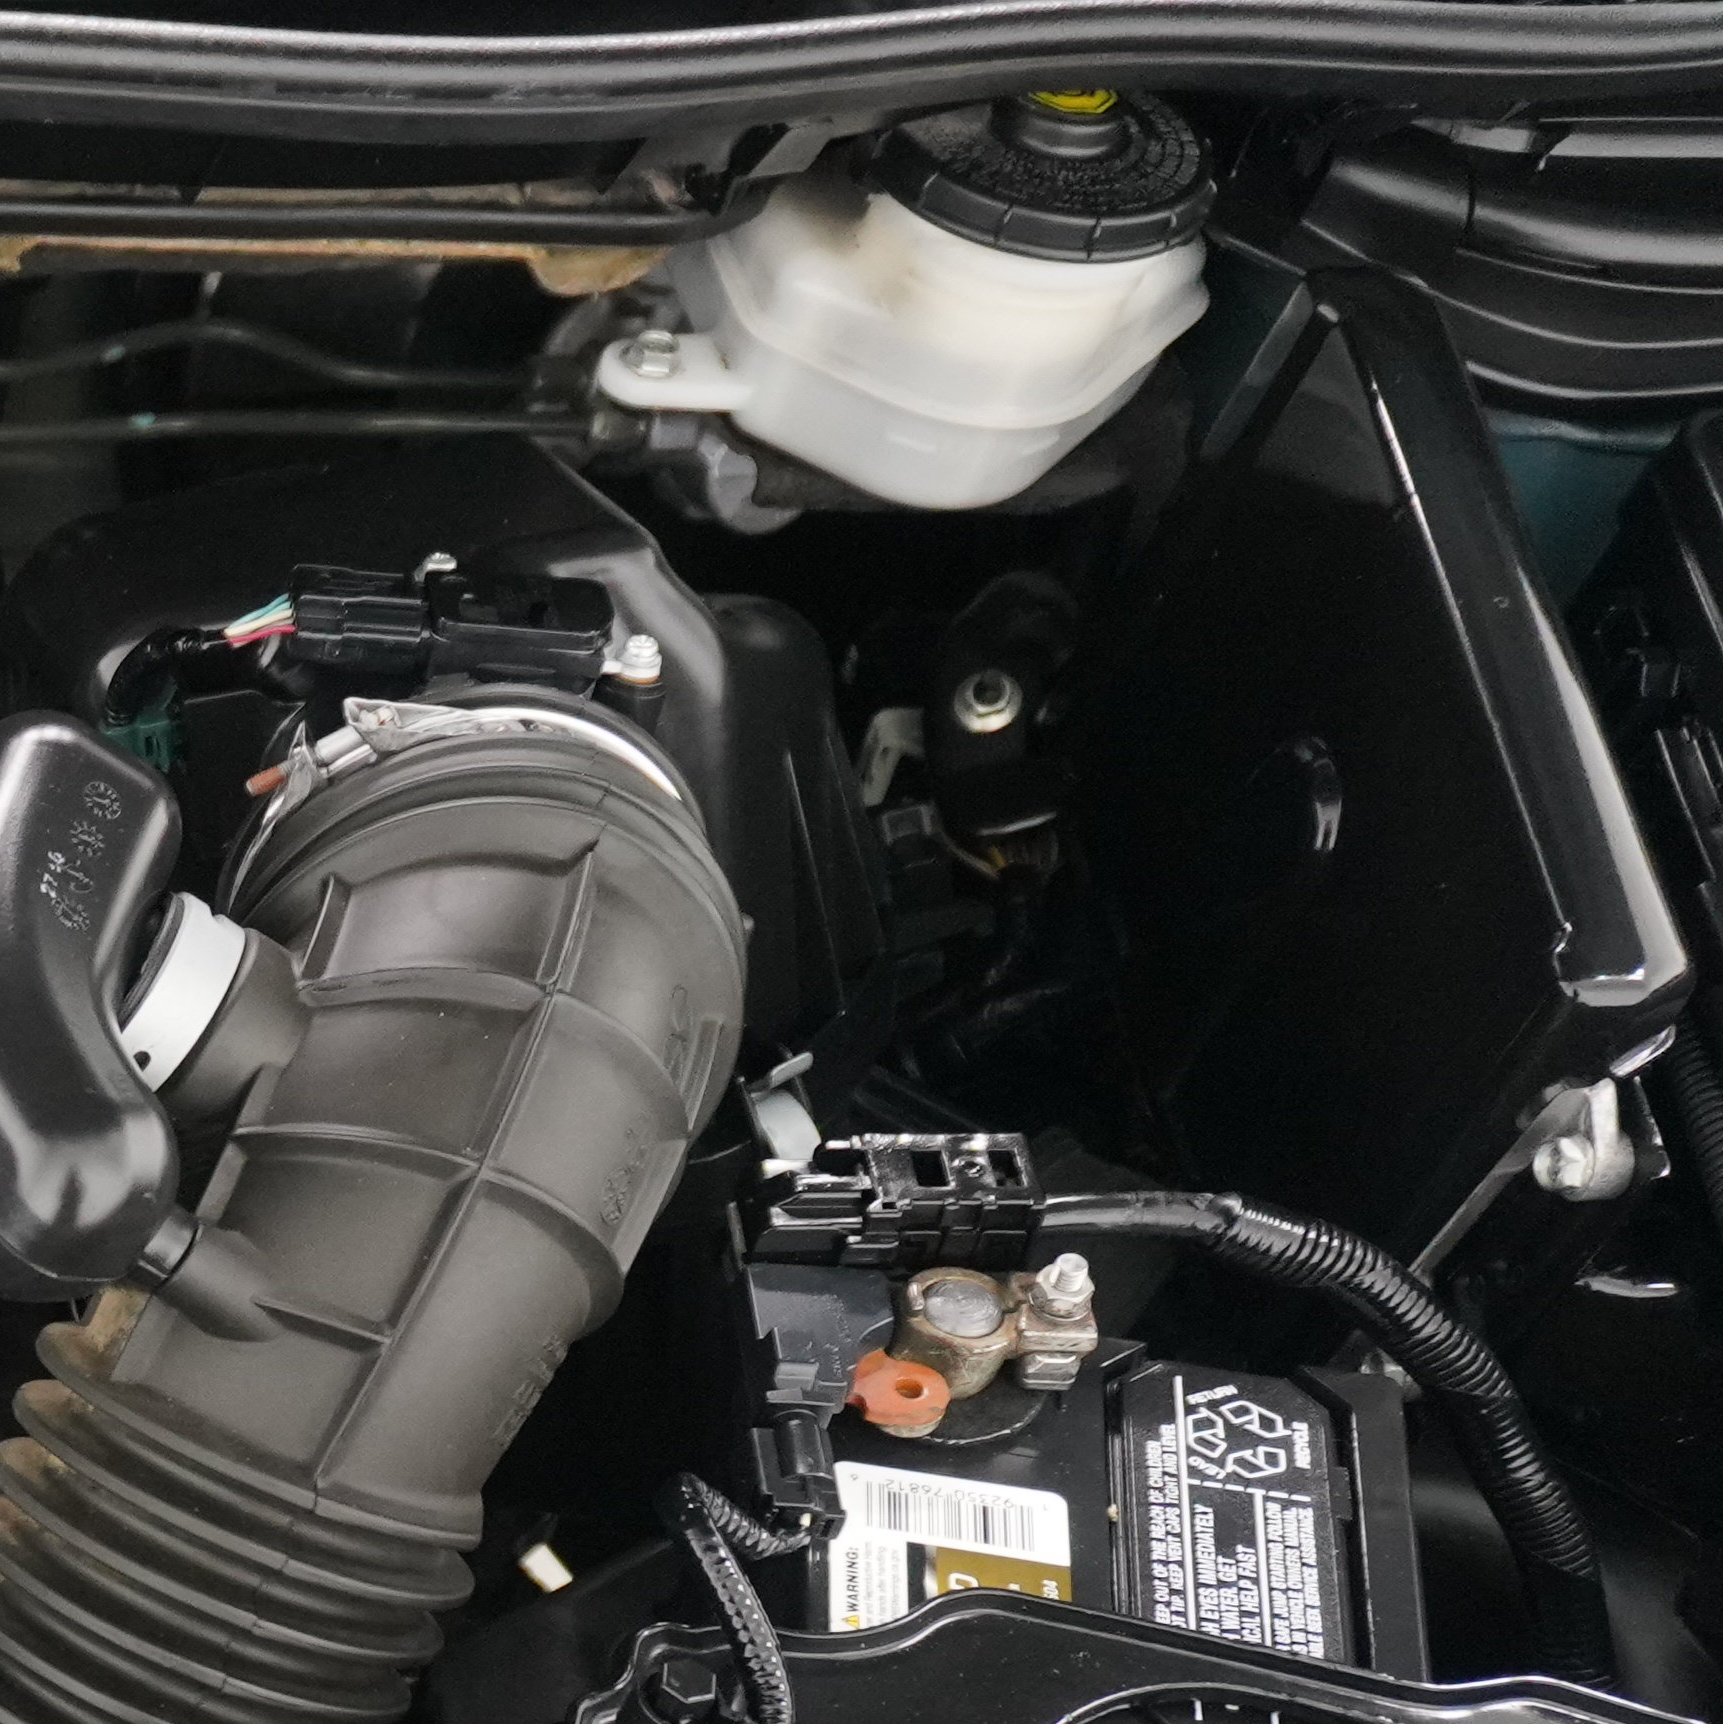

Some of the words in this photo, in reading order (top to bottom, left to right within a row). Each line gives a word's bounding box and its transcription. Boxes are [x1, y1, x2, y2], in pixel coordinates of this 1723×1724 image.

[1292, 1422, 1311, 1469] RECYCLE
[1146, 1440, 1164, 1487] CHILDREN
[1163, 1453, 1177, 1474] AND
[884, 1479, 943, 1497] 76812
[955, 1489, 1013, 1508] 92350
[1148, 1489, 1164, 1503] OF
[1164, 1476, 1179, 1504] TIGHT
[1149, 1506, 1166, 1539] REACH
[1165, 1508, 1181, 1533] CAPS
[1265, 1501, 1283, 1541] FOLLOW
[1151, 1541, 1167, 1560] THE
[1167, 1536, 1182, 1561] VENT
[1194, 1504, 1217, 1585] IMMEDIATELY
[1152, 1564, 1168, 1578] OF
[1217, 1556, 1238, 1581] GET
[1236, 1545, 1257, 1578] FAST
[1268, 1542, 1287, 1589] STARTING
[846, 1547, 859, 1612] WARNING:
[1153, 1579, 1169, 1602] OUT
[1168, 1564, 1184, 1590] KEEP
[1302, 1566, 1321, 1606] SERVICE
[1198, 1587, 1219, 1620] EYES
[1239, 1580, 1259, 1612] HELP
[1271, 1590, 1289, 1617] JUMP
[1287, 1590, 1305, 1630] VEHICLE
[1306, 1607, 1323, 1633] SEEK
[1273, 1618, 1291, 1643] SAFE
